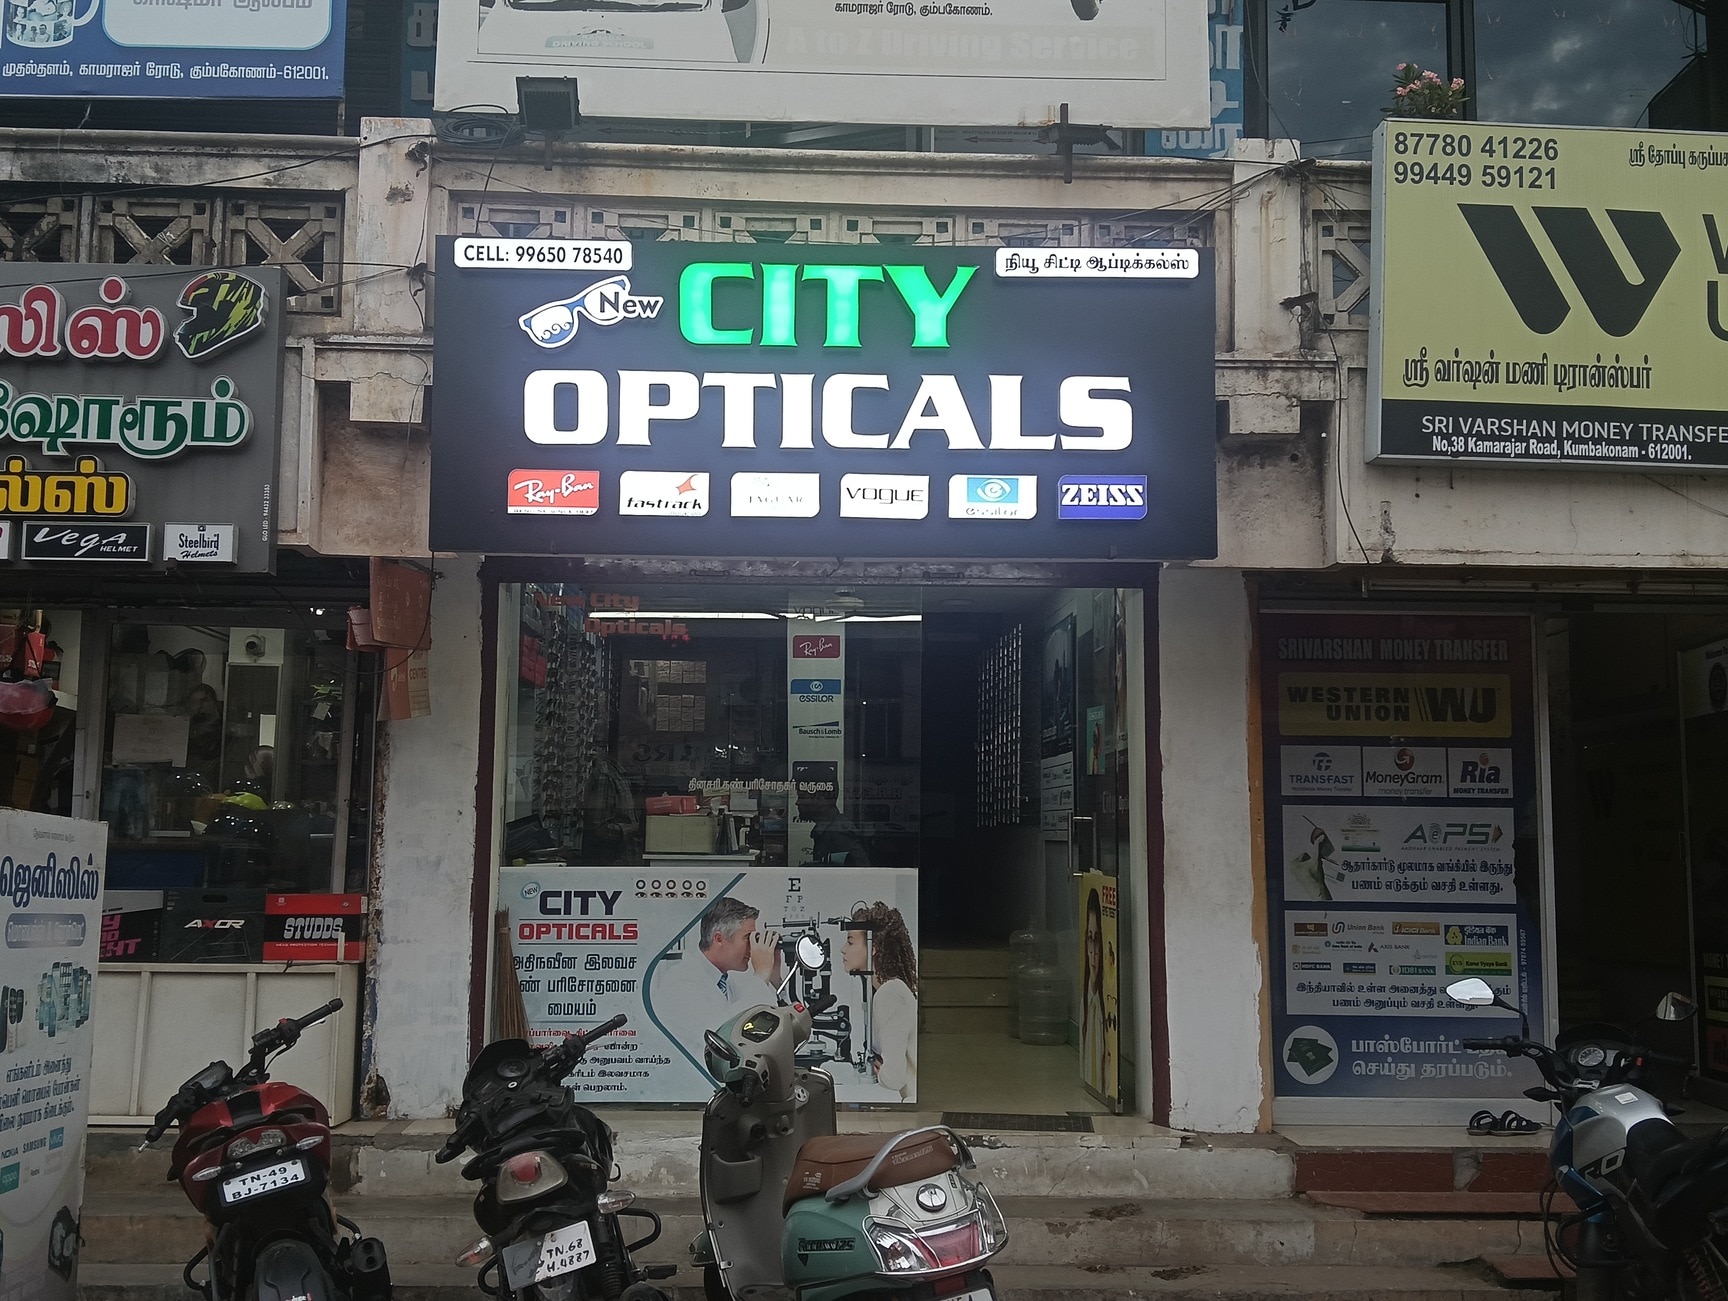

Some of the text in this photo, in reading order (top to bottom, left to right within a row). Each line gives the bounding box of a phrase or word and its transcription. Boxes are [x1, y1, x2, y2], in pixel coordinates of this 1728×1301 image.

[79, 61, 140, 77] காமராஜர்
[1394, 132, 1559, 161] 87780 41226
[1394, 161, 1556, 189] 99449 59121
[464, 245, 623, 264] CELL: 99650 78540
[1005, 253, 1039, 273] நியூ
[1044, 253, 1081, 272] சிட்டி
[600, 262, 980, 348] New CITY
[1434, 347, 1500, 390] வர்ஷன்
[1505, 352, 1548, 386] மணி
[524, 369, 1133, 451] OPTICALS
[1421, 416, 1453, 433] SRI
[1458, 416, 1556, 437] VARSHAN
[1562, 420, 1634, 440] MONEY
[1468, 437, 1526, 458] Kamarajar
[1529, 439, 1561, 458] Road,
[1563, 440, 1638, 458] Kumbakonam
[1648, 443, 1692, 460] 612001.
[514, 473, 594, 503] Ray-Ban
[1061, 484, 1144, 506] ZEISS
[627, 497, 702, 510] fastrack
[100, 545, 138, 553] HELMET
[178, 533, 219, 550] Steelbird
[181, 550, 218, 560] Helmets
[583, 619, 687, 638] Opticals
[1380, 638, 1431, 661] MONEY
[1434, 639, 1508, 661] TRANSFER
[1286, 686, 1410, 704] WESTERN
[1424, 687, 1497, 723] WU
[1326, 704, 1410, 721] UNION
[1365, 771, 1443, 787] MoneyGram
[1460, 756, 1501, 784] Ria
[788, 878, 801, 892] E
[1102, 885, 1116, 906] FREE
[524, 886, 622, 915] NEW CITY
[184, 919, 245, 929] AXOR
[283, 917, 343, 939] STUDDS
[519, 923, 638, 940] OPTICALS
[584, 954, 637, 970] இலவச
[547, 998, 596, 1015] மையம்
[1352, 1057, 1416, 1079] செய்து
[23, 1137, 46, 1153] SAMSUNG
[232, 1173, 300, 1200] BJ-7134
[239, 1166, 287, 1187] TN-49
[546, 1238, 583, 1259] TN.68
